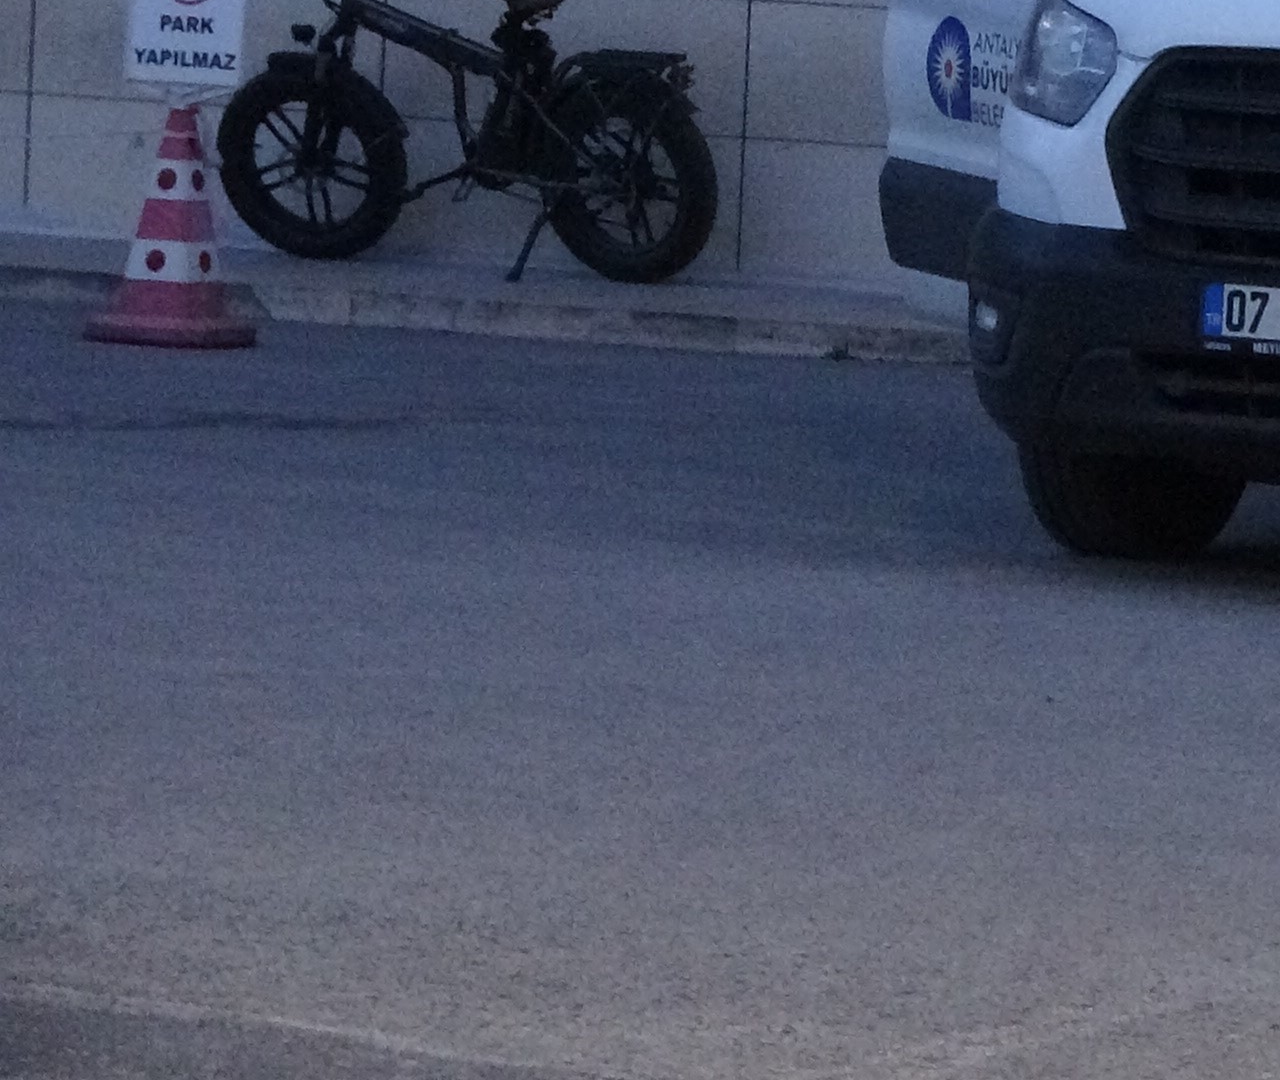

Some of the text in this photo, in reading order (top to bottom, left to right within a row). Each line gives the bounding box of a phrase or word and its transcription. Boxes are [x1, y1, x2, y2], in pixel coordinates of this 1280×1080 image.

[160, 14, 214, 35] PARK
[134, 47, 237, 71] YAPILMAZ
[974, 32, 1022, 60] ANTALY
[972, 60, 1013, 95] BÜYÜ
[1225, 289, 1269, 334] 07
